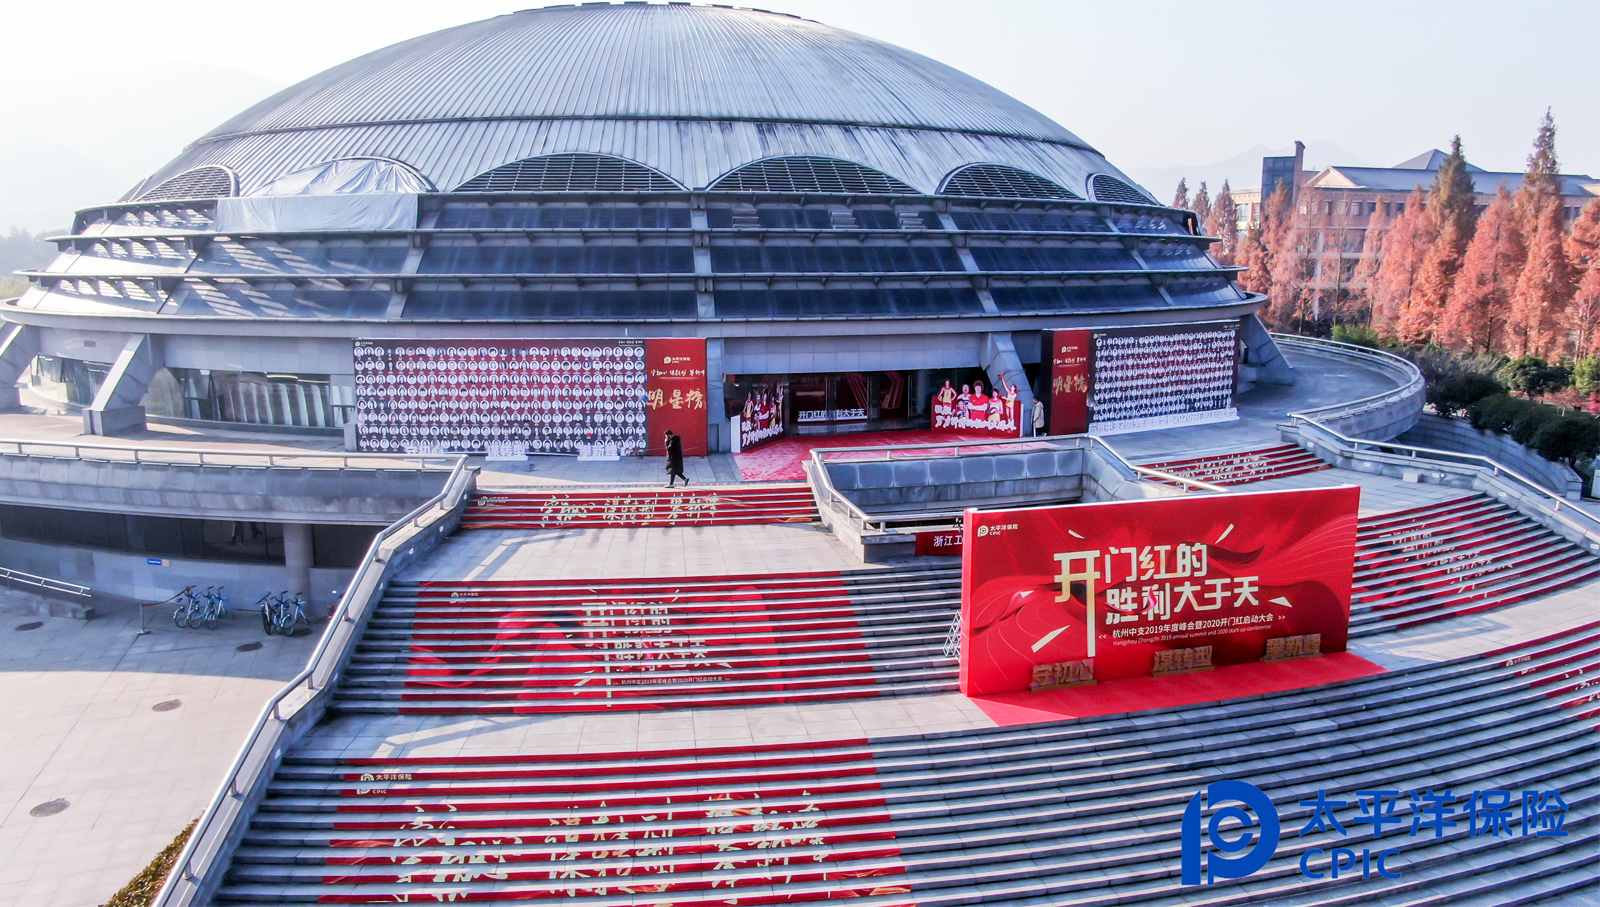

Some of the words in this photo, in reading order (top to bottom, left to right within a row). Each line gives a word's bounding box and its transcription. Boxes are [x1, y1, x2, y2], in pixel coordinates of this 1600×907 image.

[648, 388, 704, 410] 明星榜
[989, 523, 1019, 532] 太平洋保险
[1053, 541, 1208, 658] 开门红的
[1105, 575, 1259, 625] 胜利大于天
[1112, 613, 1274, 638] 杭州中支2019年度峰会暨2020开门红启动大会
[1160, 633, 1172, 641] 2019
[1172, 632, 1189, 640] annual
[1189, 630, 1207, 638] summit
[1207, 629, 1216, 637] and
[1246, 624, 1272, 633] conference
[1032, 659, 1094, 686] 守初心
[1153, 645, 1213, 671] 谋转型
[1266, 633, 1321, 658] 攀新峰
[375, 773, 413, 781] 太平洋保险
